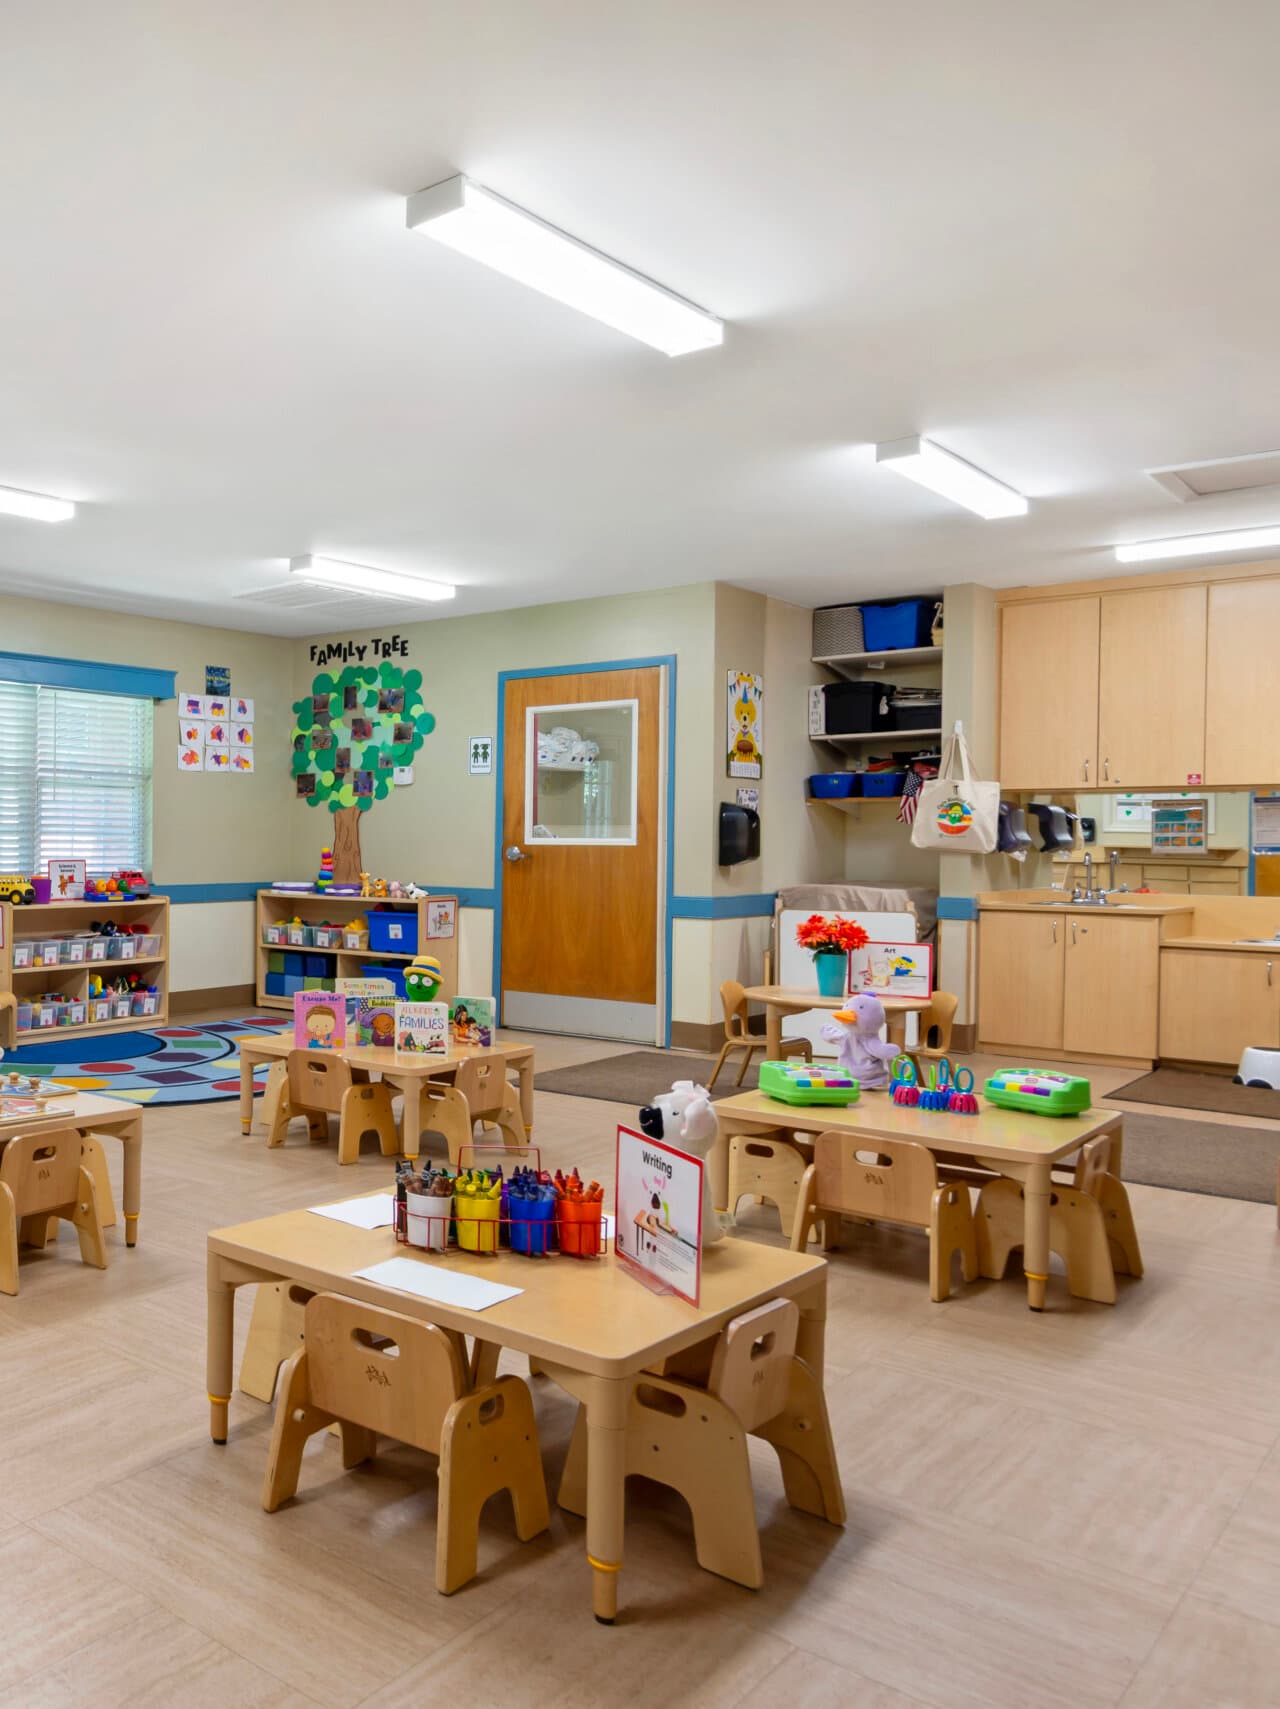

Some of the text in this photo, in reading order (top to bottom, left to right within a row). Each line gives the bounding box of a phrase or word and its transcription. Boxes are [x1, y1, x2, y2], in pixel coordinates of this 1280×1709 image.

[309, 635, 409, 666] FAMILY TREE
[399, 1016, 445, 1030] FAMILIES
[641, 1150, 673, 1179] Writing
